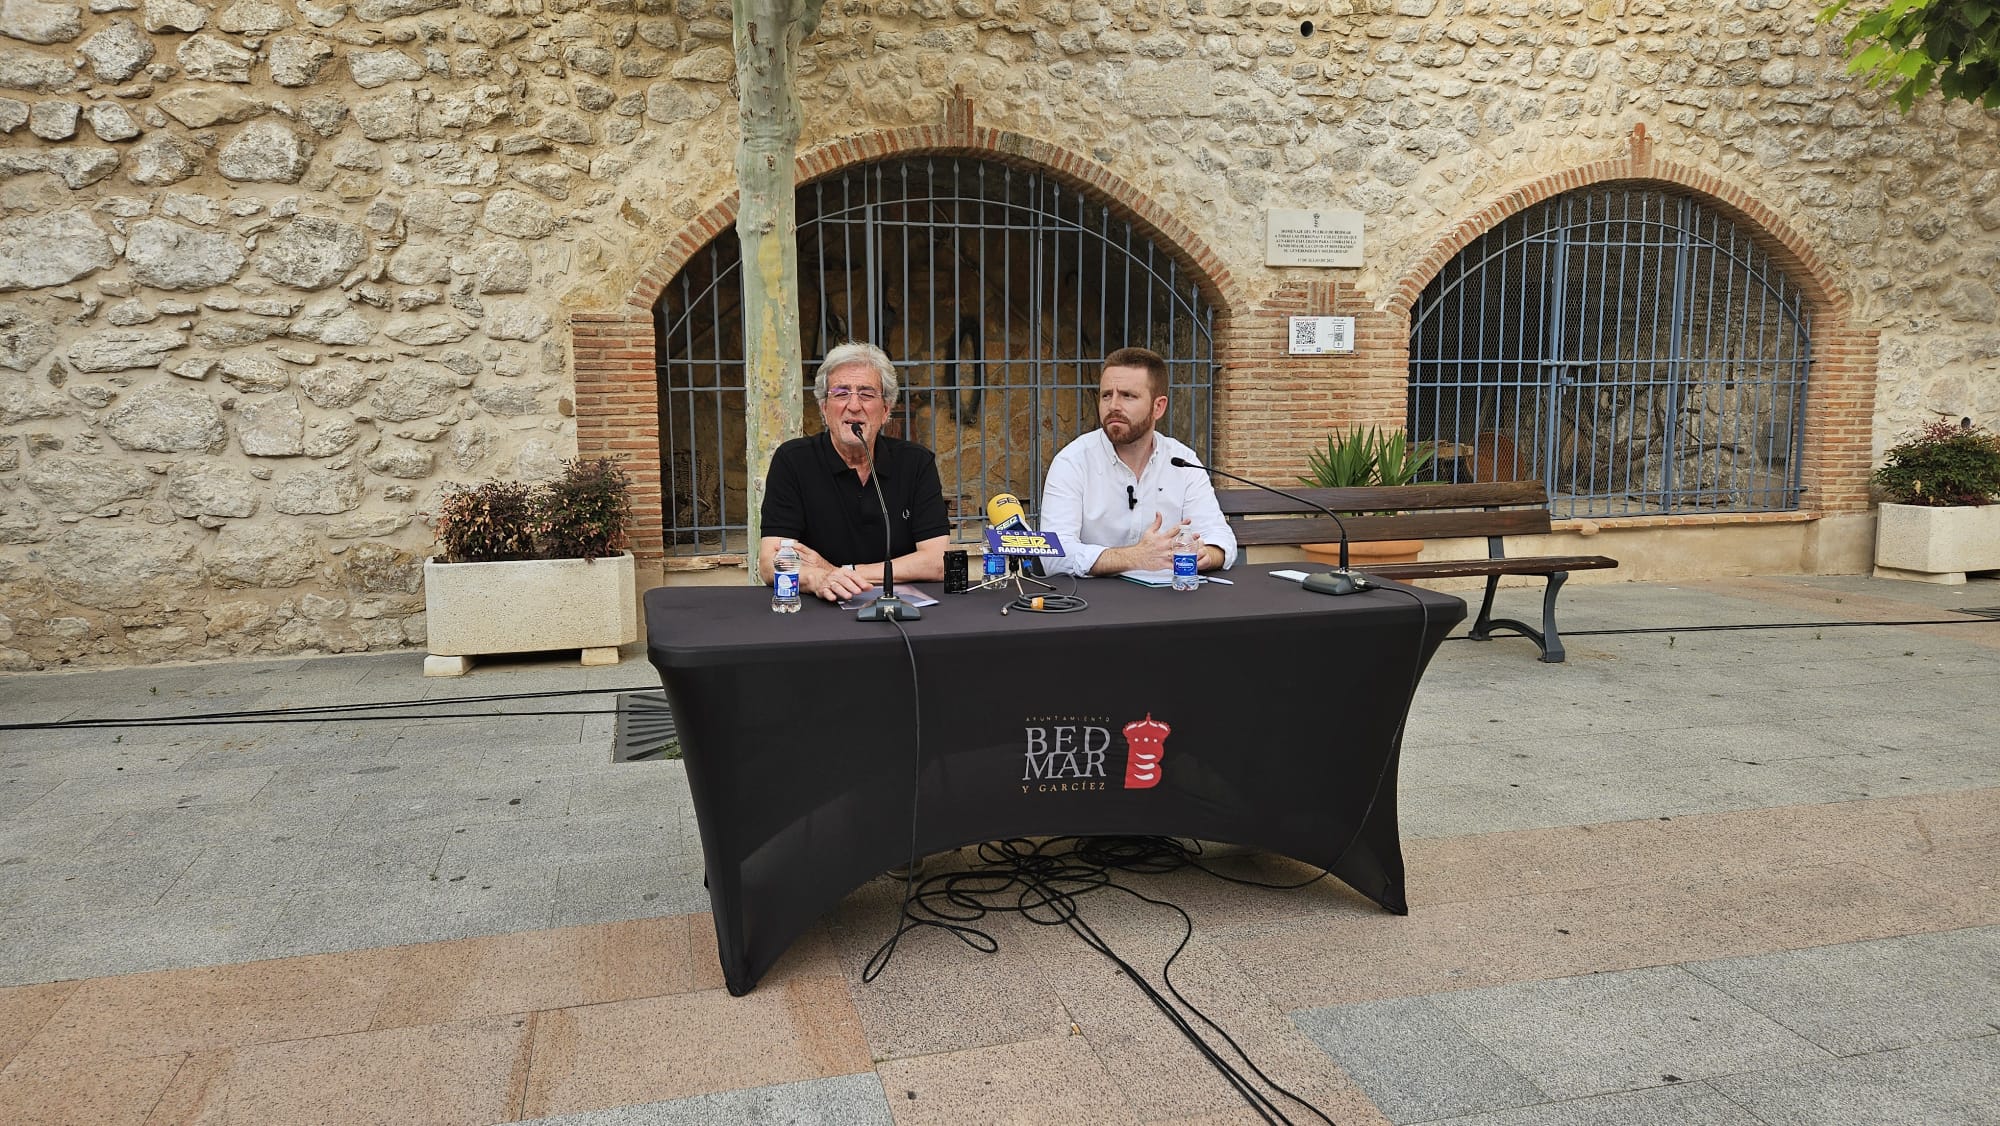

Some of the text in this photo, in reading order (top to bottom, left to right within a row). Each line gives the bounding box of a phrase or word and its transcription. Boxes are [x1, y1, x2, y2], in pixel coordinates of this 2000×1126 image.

[996, 515, 1018, 531] SER
[1001, 535, 1050, 548] SER
[998, 546, 1026, 554] RADIO
[1025, 726, 1111, 756] BED
[1022, 751, 1107, 780] MAR
[1022, 781, 1105, 793] Y GARCÍEZ
